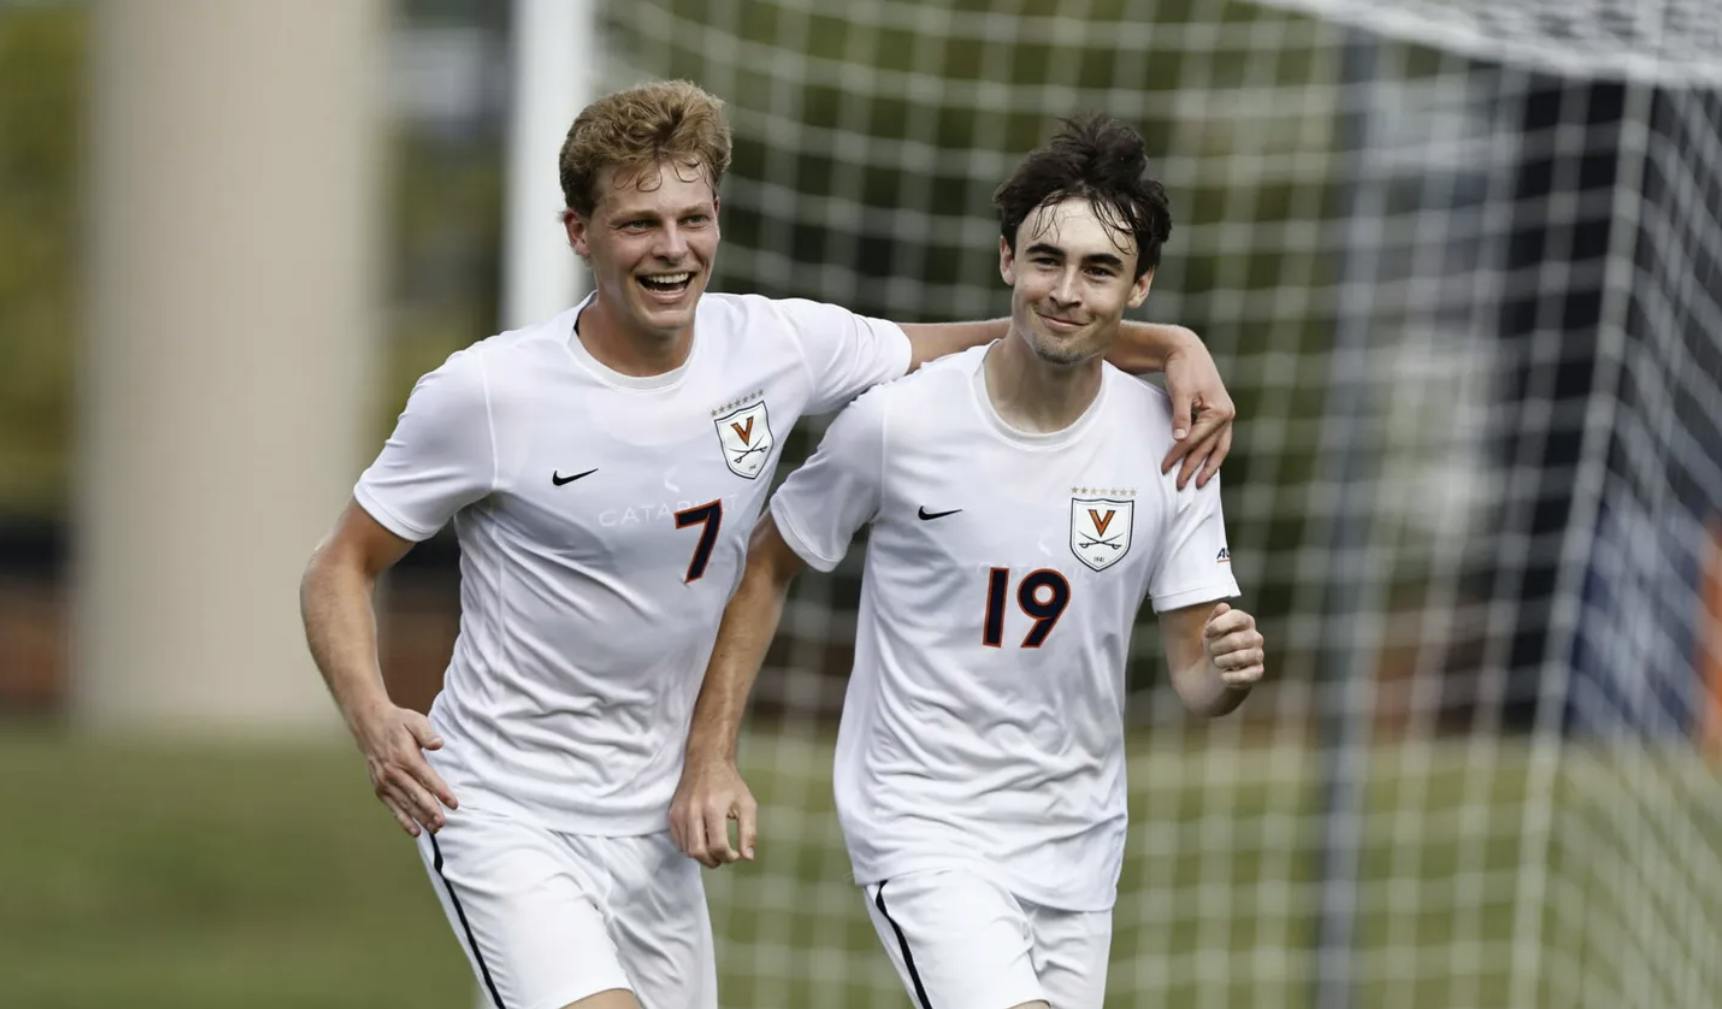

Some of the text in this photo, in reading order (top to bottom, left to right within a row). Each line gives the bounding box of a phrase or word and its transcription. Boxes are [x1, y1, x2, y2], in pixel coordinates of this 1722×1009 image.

[730, 416, 754, 446] V
[673, 498, 724, 584] 7
[1087, 509, 1117, 537] V
[982, 567, 1072, 648] 19
